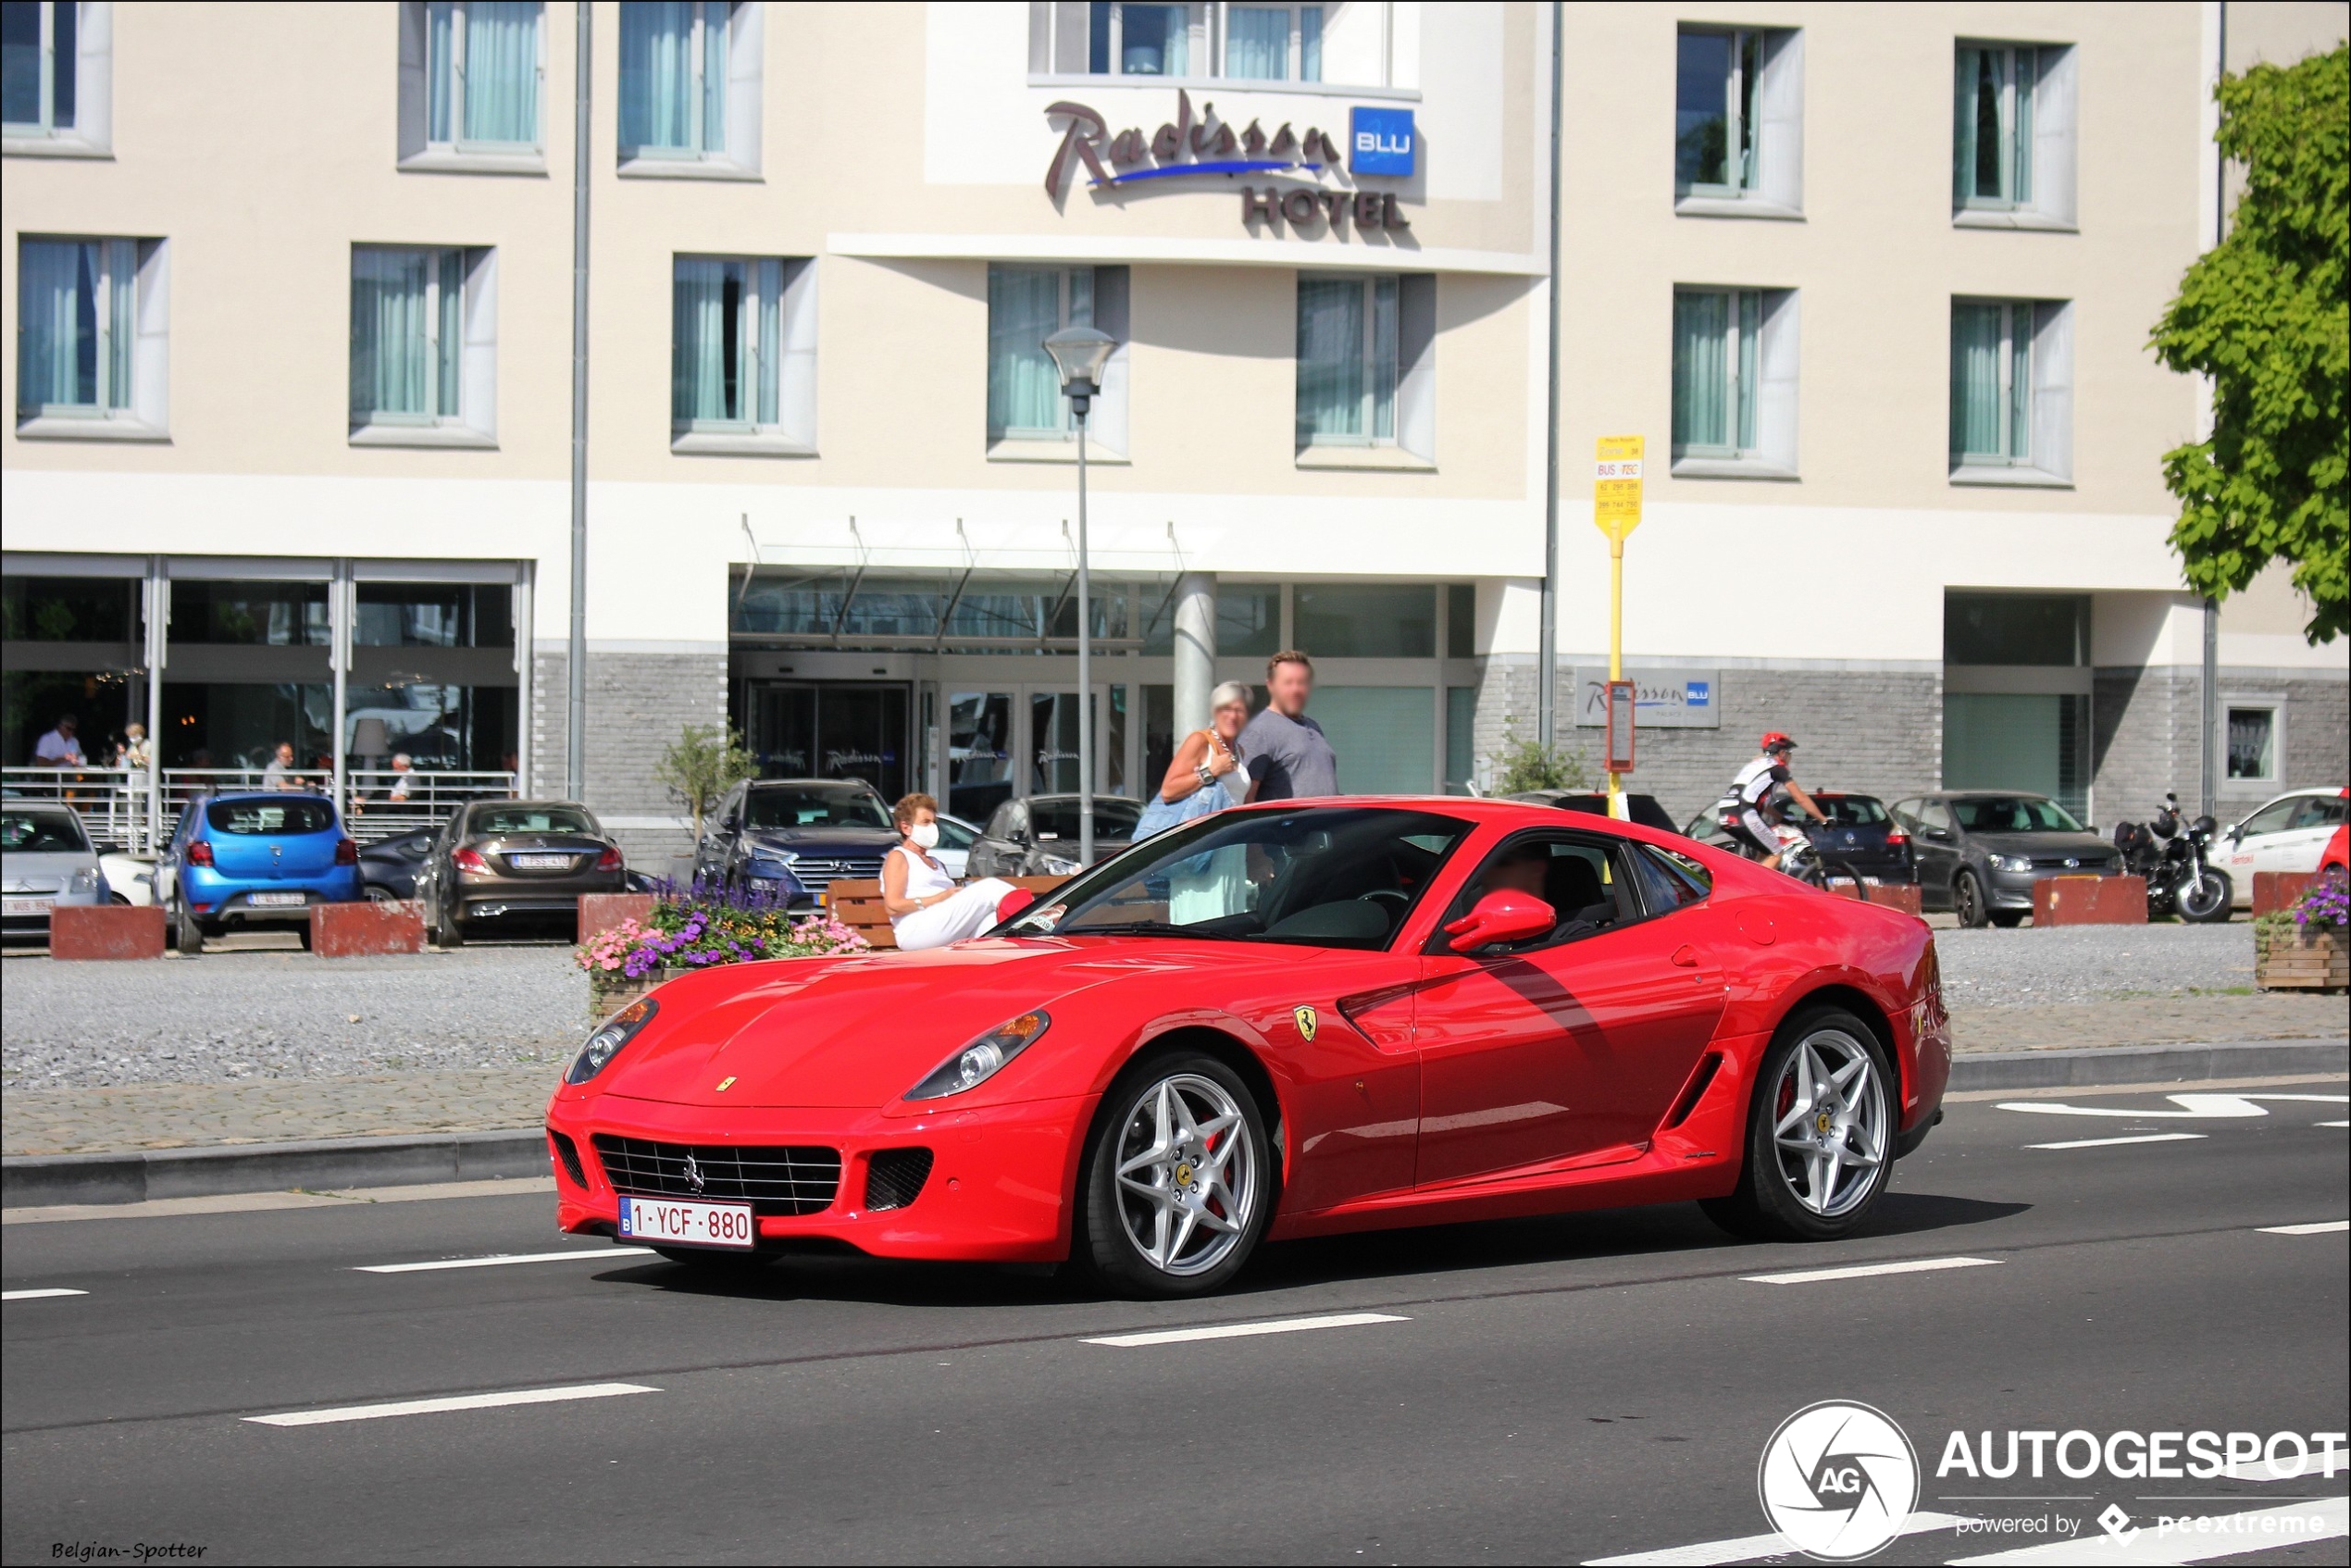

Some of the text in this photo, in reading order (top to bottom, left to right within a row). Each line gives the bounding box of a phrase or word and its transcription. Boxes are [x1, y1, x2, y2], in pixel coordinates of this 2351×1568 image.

[1044, 89, 1410, 200] Radisson BLU
[1241, 186, 1411, 229] HOTEL
[1598, 464, 1638, 476] BUS TEC
[1687, 691, 1708, 700] BLU
[623, 1219, 631, 1232] B
